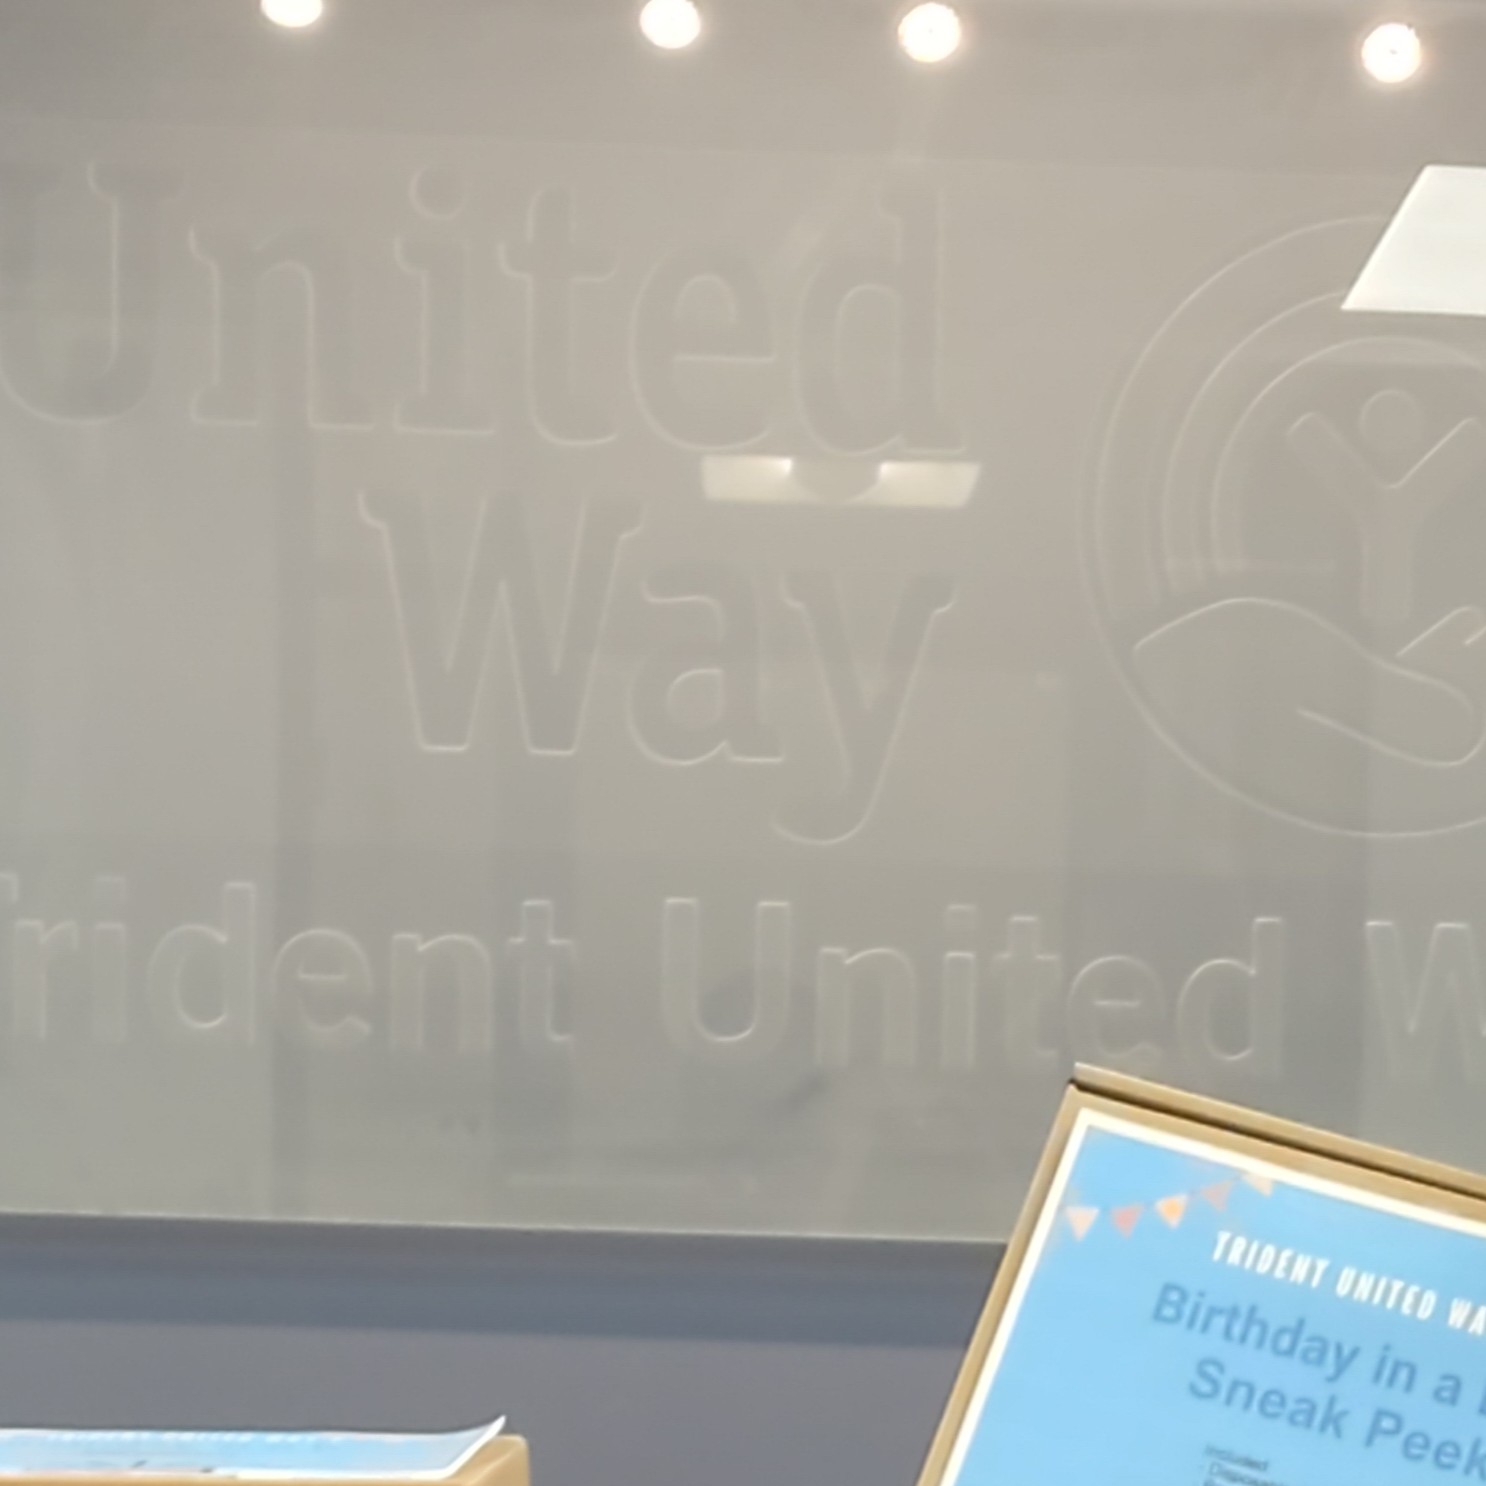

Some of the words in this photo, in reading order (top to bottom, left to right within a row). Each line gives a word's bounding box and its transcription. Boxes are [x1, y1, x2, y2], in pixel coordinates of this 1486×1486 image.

[0, 158, 968, 458] United
[358, 488, 958, 846] Way
[0, 873, 577, 1054] rident
[660, 896, 1285, 1076] United
[1150, 1280, 1361, 1384] Birthday
[1371, 1344, 1419, 1394] in
[1432, 1373, 1464, 1407] a
[1212, 1230, 1331, 1290] TRIDENT
[1336, 1266, 1438, 1321] UNITED
[1188, 1356, 1351, 1440] Sneak
